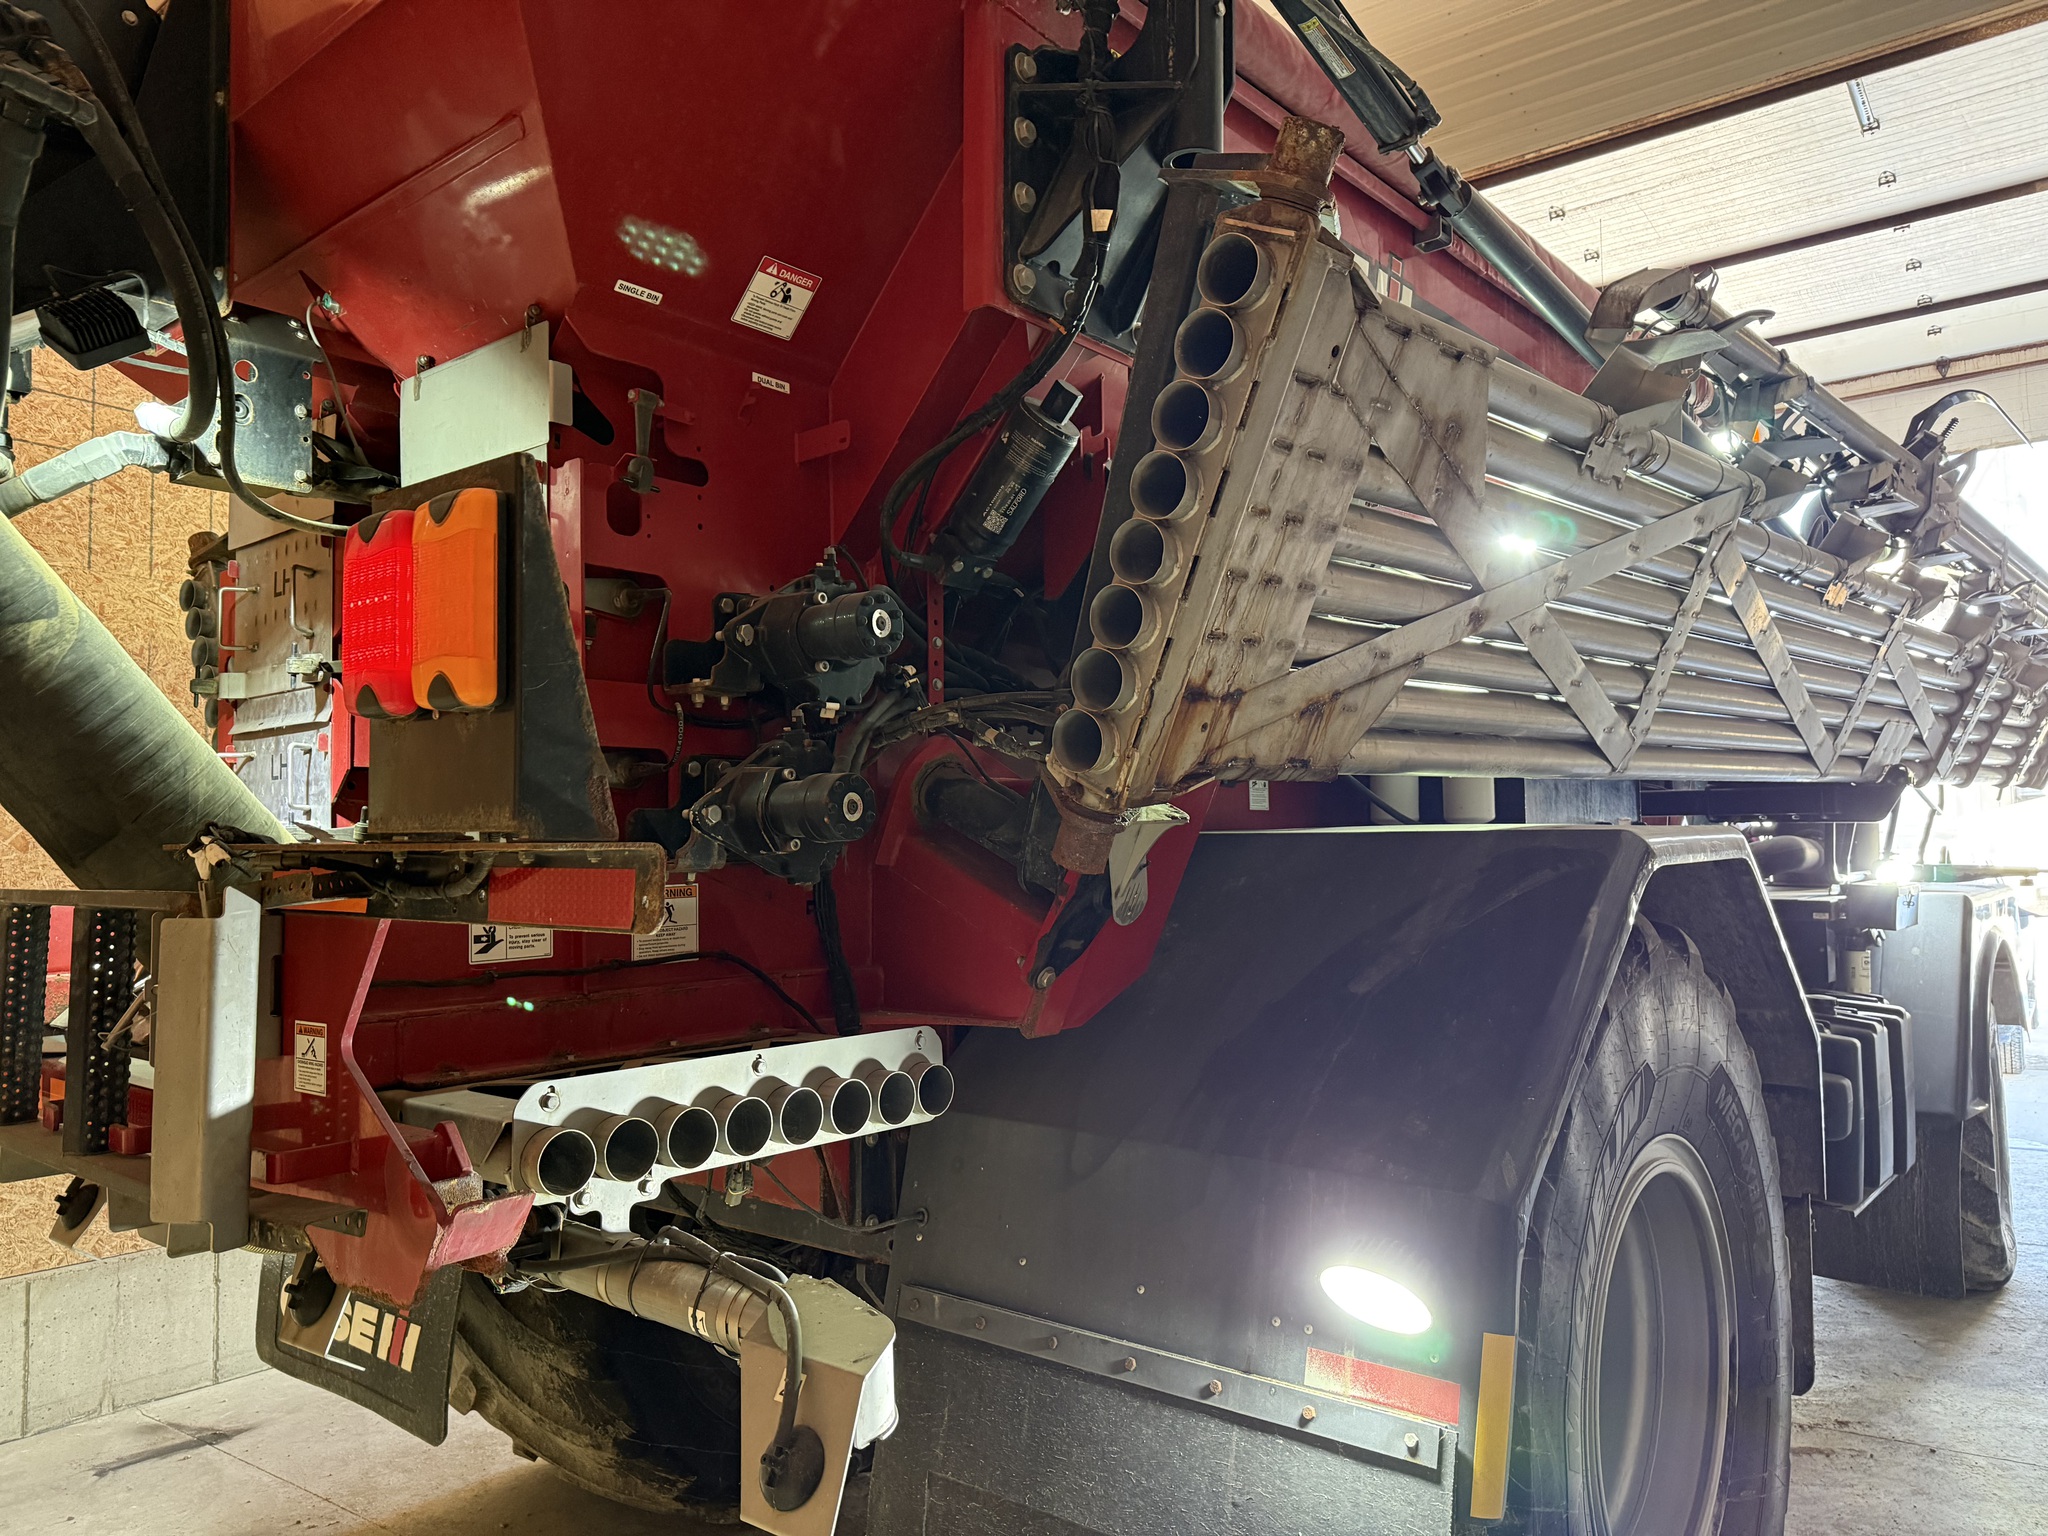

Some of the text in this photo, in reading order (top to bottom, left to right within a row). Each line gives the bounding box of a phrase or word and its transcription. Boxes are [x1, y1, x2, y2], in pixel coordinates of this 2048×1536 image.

[779, 269, 813, 288] DANGER
[618, 283, 660, 302] SINGLE BIN
[757, 376, 786, 390] DUAL BIN
[1006, 487, 1027, 516] SALFORD
[664, 888, 692, 897] RNING
[304, 1026, 323, 1036] WARNING
[1714, 1083, 1766, 1236] MEGAXBIB
